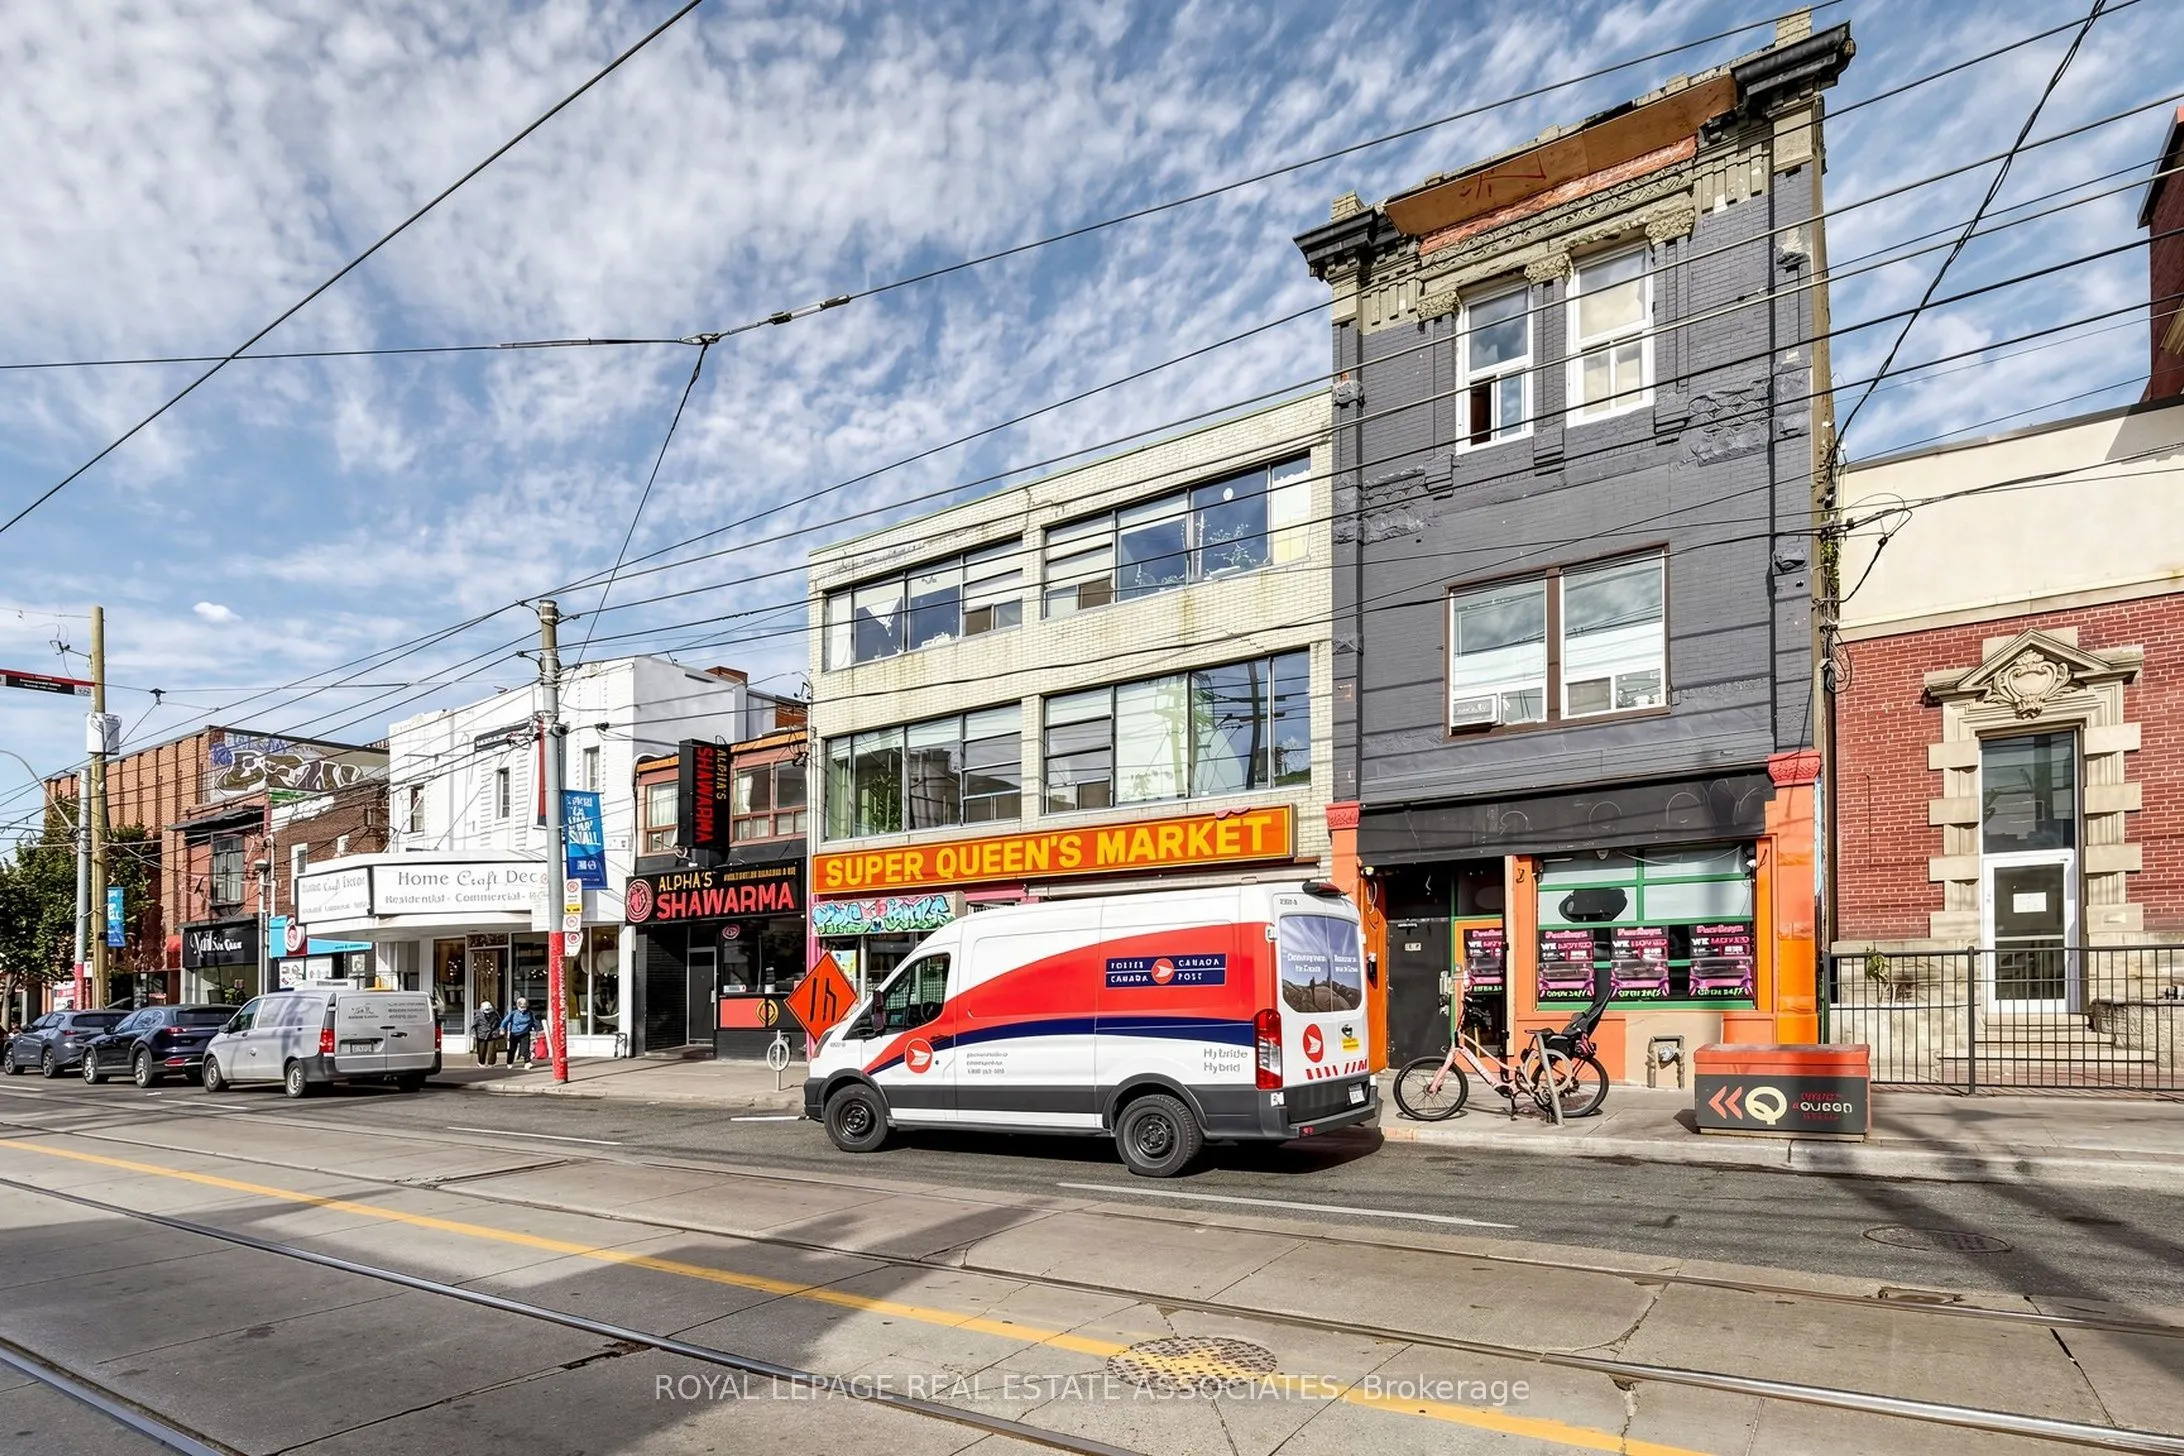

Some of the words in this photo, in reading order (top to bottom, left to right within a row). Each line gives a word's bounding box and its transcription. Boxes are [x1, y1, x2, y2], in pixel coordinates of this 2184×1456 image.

[696, 746, 715, 844] SHAWARMA
[825, 851, 924, 887] SUPER
[935, 834, 1083, 880] QUEEN'S
[1096, 815, 1272, 865] MARKET
[398, 871, 449, 886] Home
[506, 870, 541, 884] Dec
[658, 870, 713, 893] ALPHA'S
[385, 893, 445, 905] Residential
[455, 891, 520, 903] Commercial
[656, 882, 795, 921] SHAWARMA
[1178, 958, 1220, 967] CANADA
[1110, 974, 1149, 983] CANADA
[1203, 1048, 1248, 1060] Hybride
[1203, 1062, 1241, 1074] Hybrid
[1744, 1086, 1788, 1126] Q
